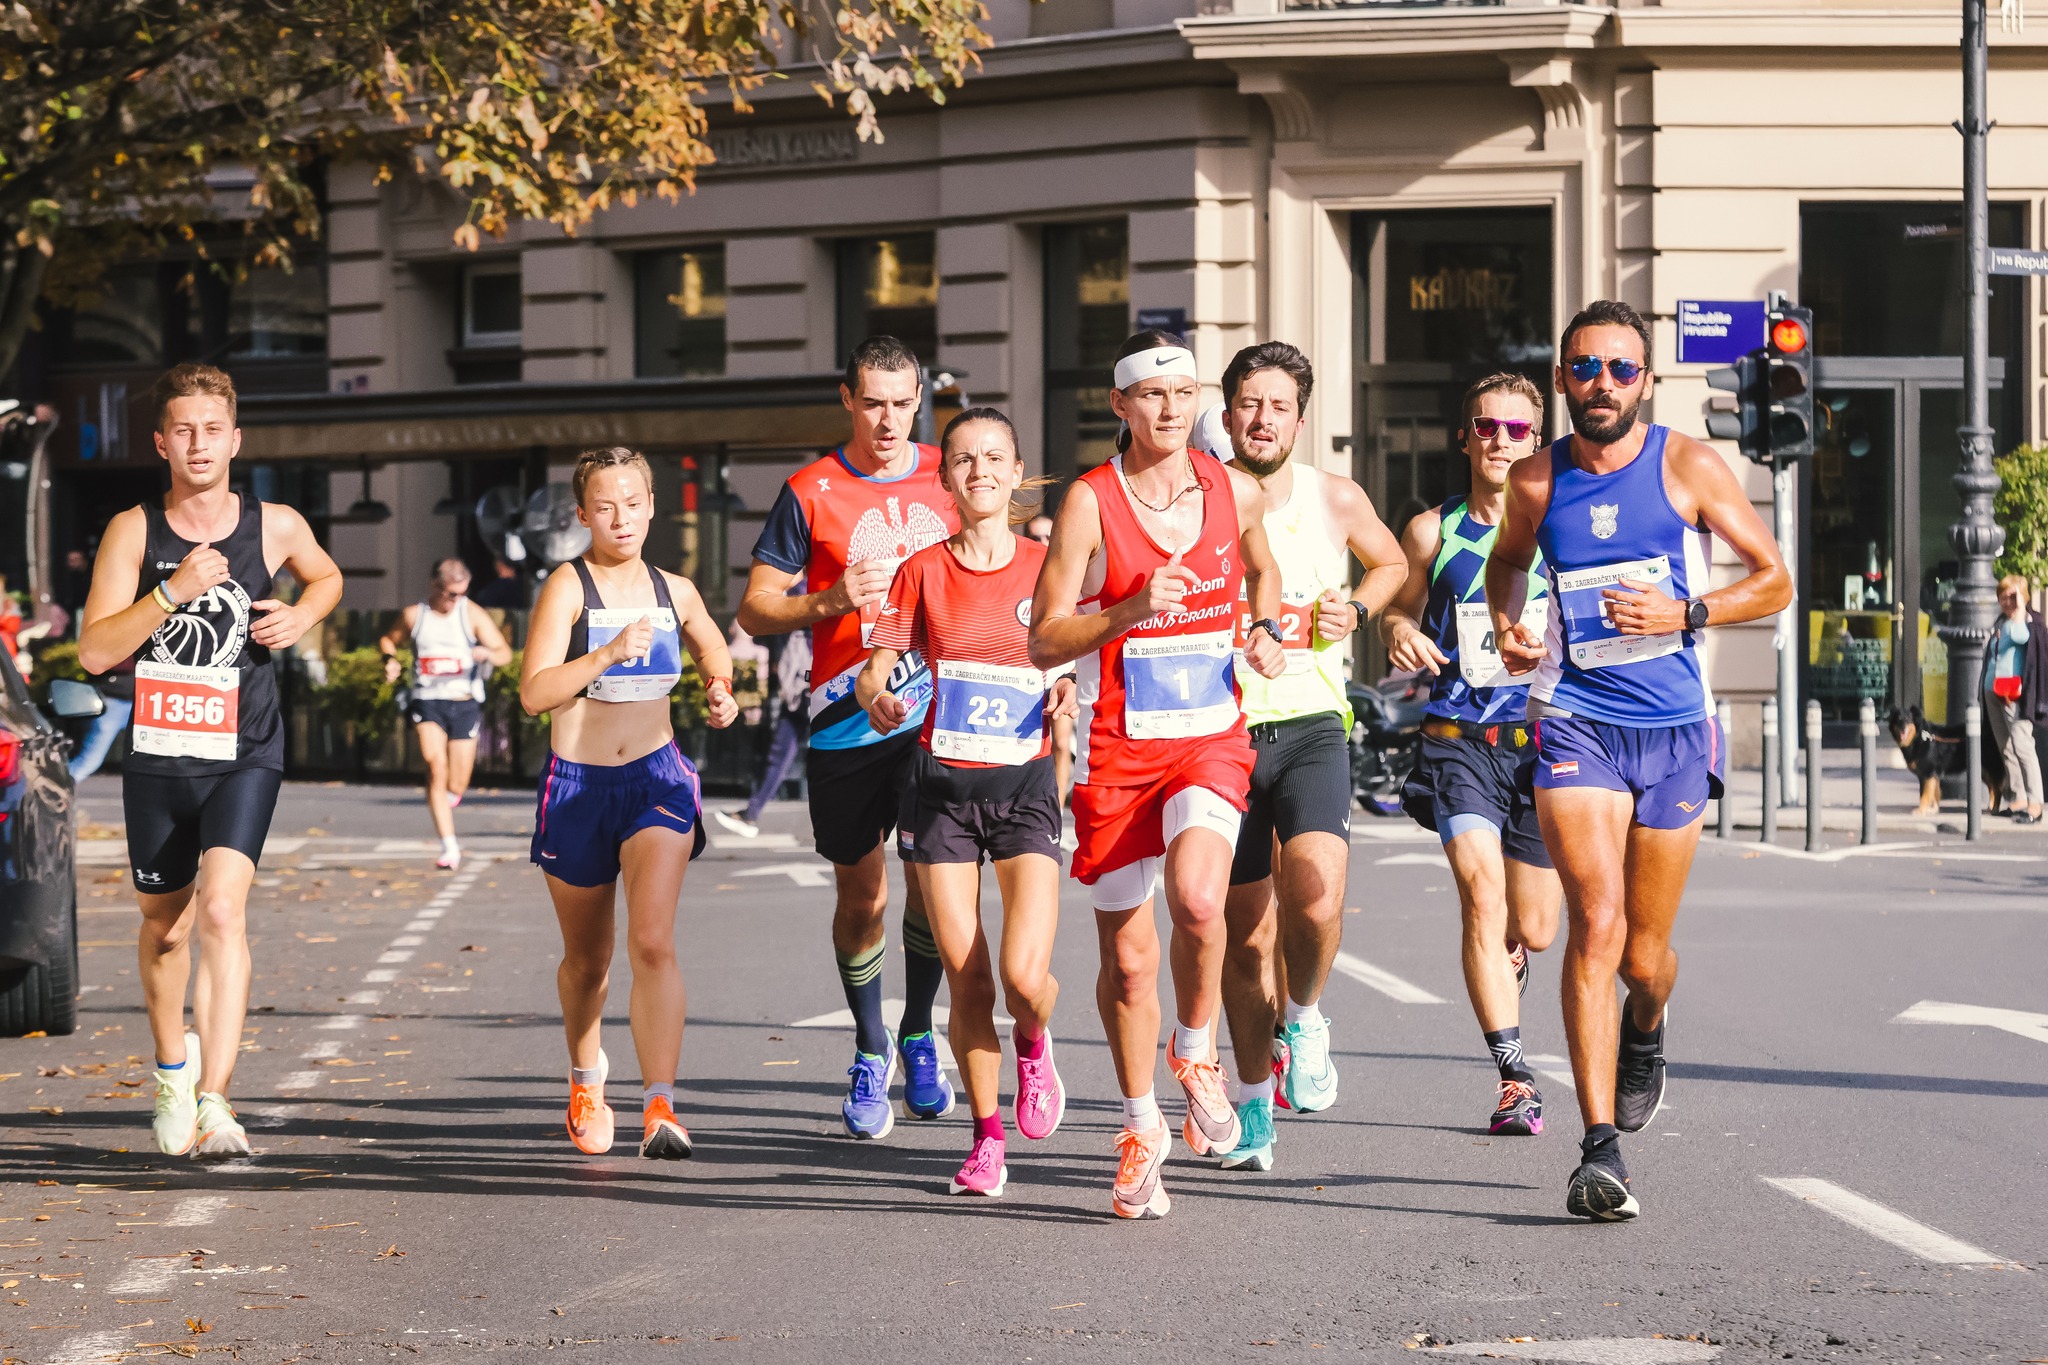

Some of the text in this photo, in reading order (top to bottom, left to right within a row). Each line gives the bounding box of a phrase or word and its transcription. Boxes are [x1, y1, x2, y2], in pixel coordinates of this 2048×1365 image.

[1575, 574, 1612, 588] ZAGREBAČKI
[1612, 569, 1641, 582] MARATON
[1178, 602, 1232, 624] CROATIA
[1141, 645, 1179, 656] ZAGREBAČKI
[1180, 643, 1210, 653] MARATON
[955, 669, 990, 681] ZAGREBAČKI
[1173, 668, 1190, 700] 1
[149, 692, 225, 726] 1356
[967, 695, 1008, 728] 23
